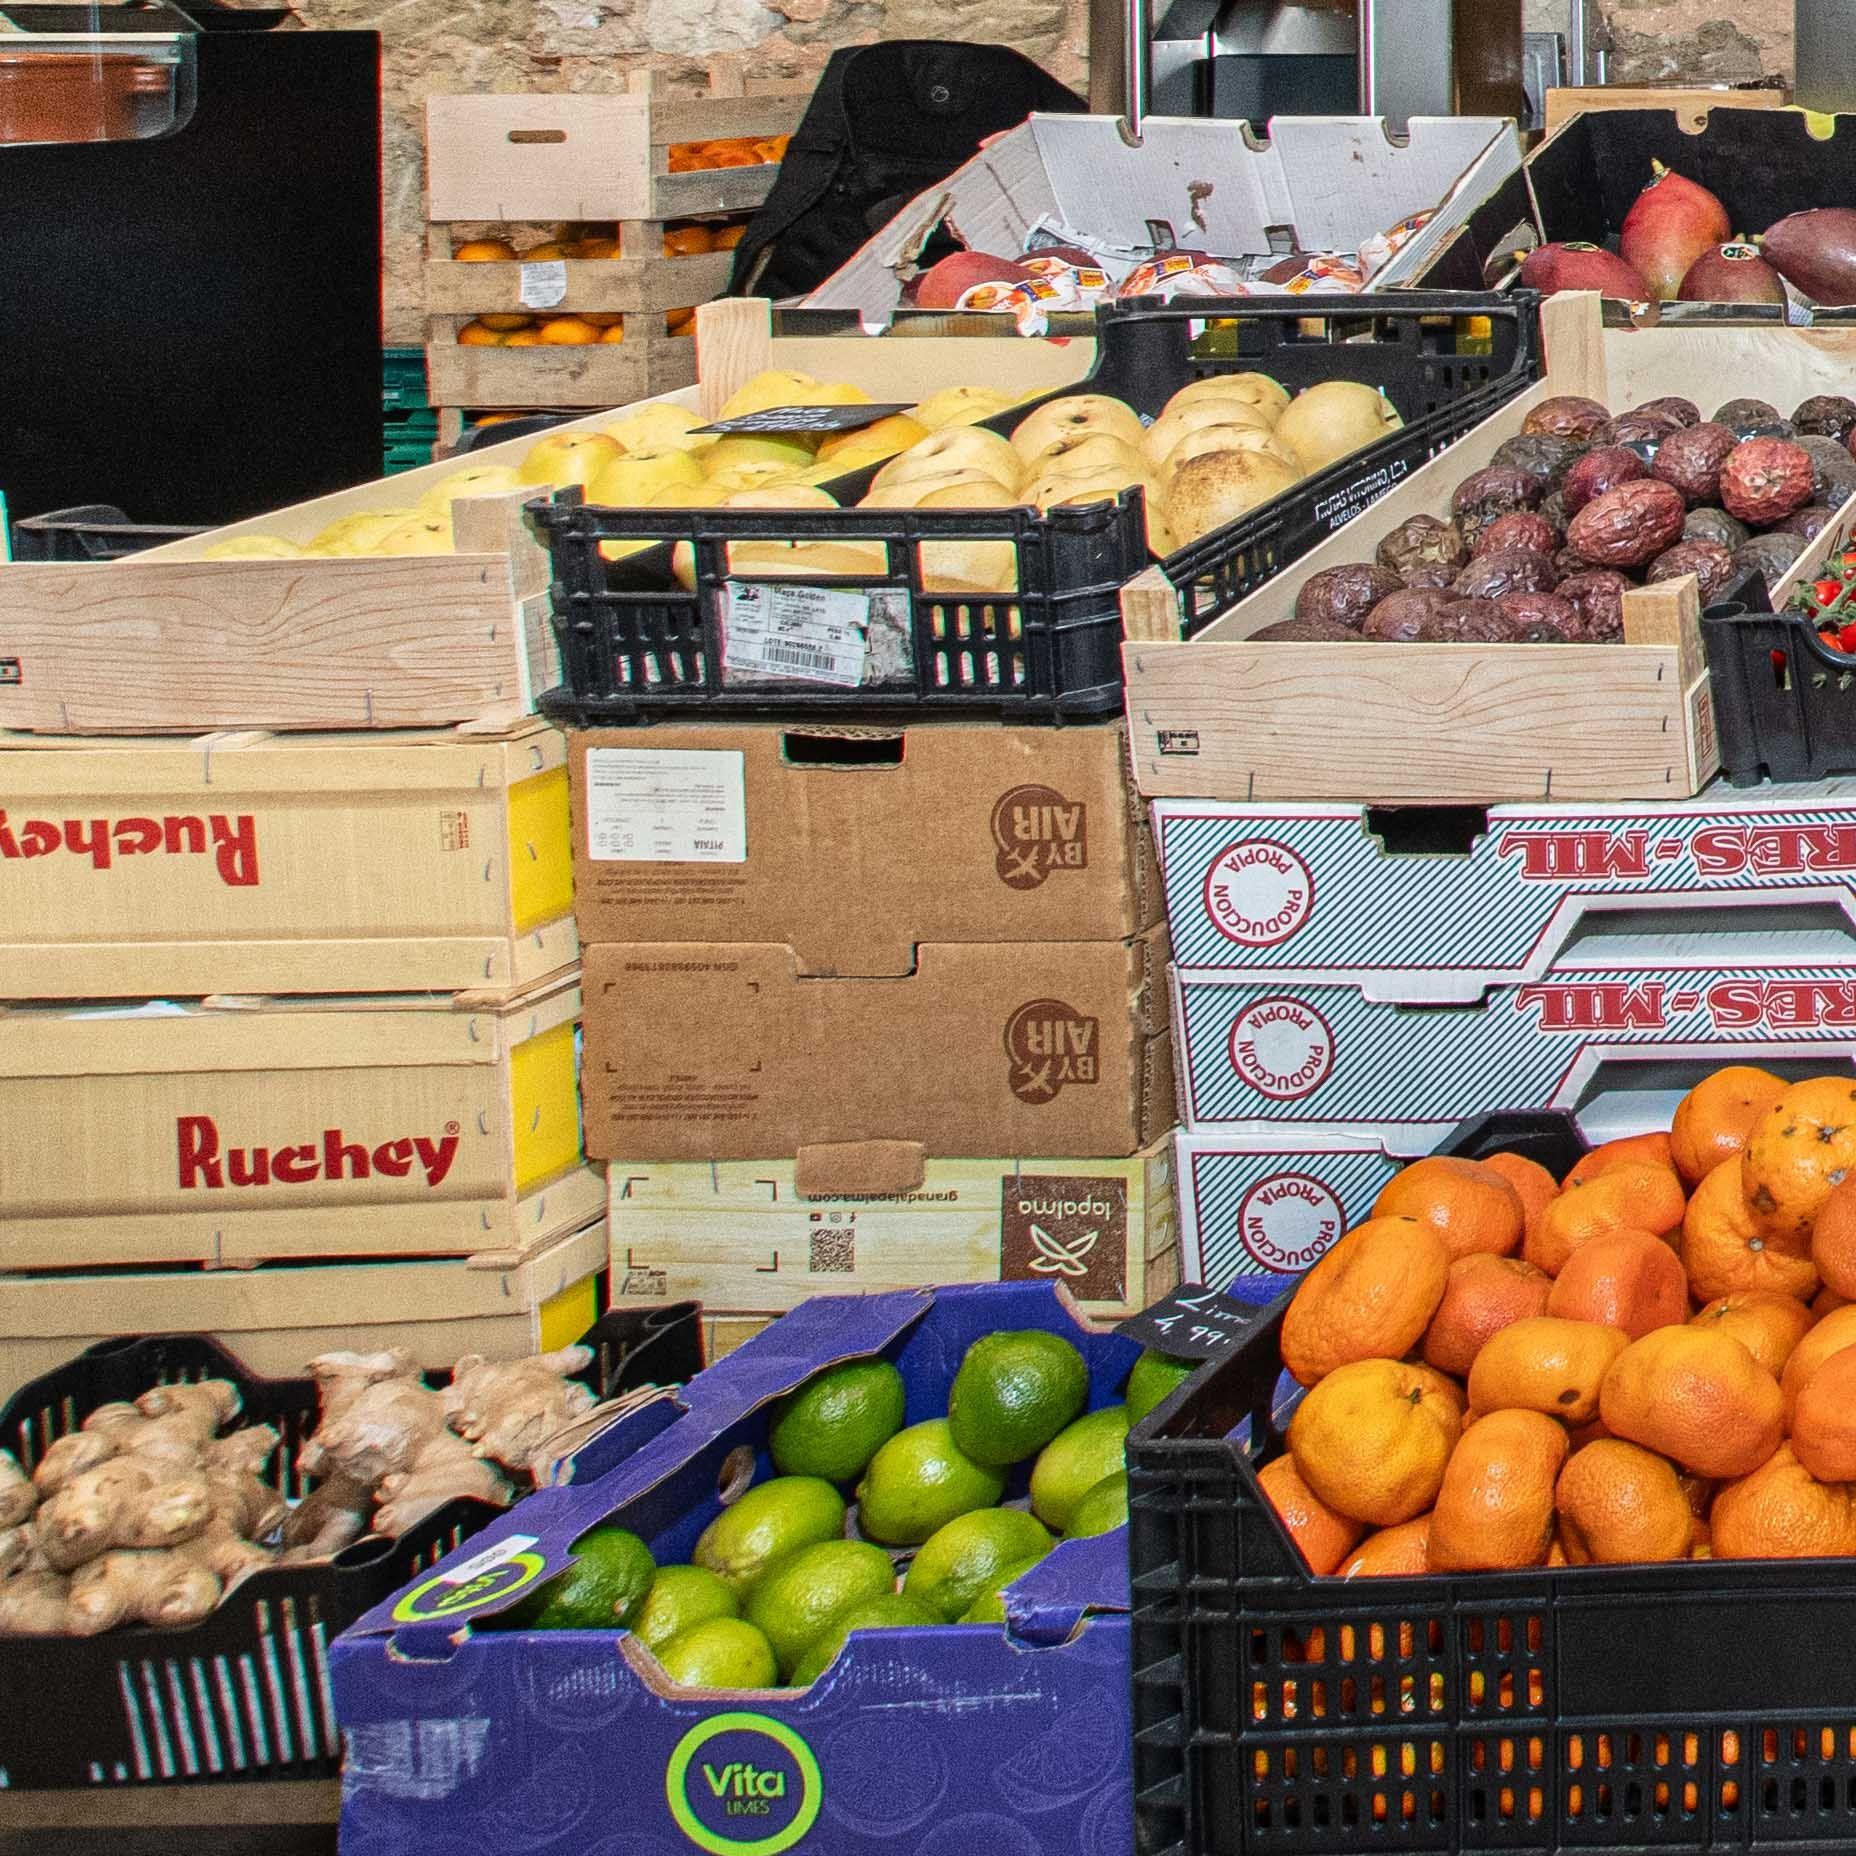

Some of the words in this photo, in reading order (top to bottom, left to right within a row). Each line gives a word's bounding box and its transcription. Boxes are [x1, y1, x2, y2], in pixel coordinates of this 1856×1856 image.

[1013, 806, 1081, 841] AIR
[1047, 842, 1083, 866] BY
[1223, 847, 1294, 876] PROPIA
[1214, 884, 1303, 937] PRODUCCION
[1246, 1005, 1314, 1032] PROPIA
[1027, 1020, 1094, 1055] AIR
[1057, 1055, 1095, 1080] BY
[1239, 1039, 1324, 1096] PRODUCCION
[176, 1115, 460, 1189] Ruchey
[808, 1191, 959, 1205] granadalapalma.com
[1018, 1194, 1111, 1221] lapalma
[1256, 1181, 1325, 1207] PROPIA
[1247, 1216, 1335, 1266] PRODUCCION
[703, 1762, 786, 1797] Vita
[726, 1799, 771, 1815] LIMES
